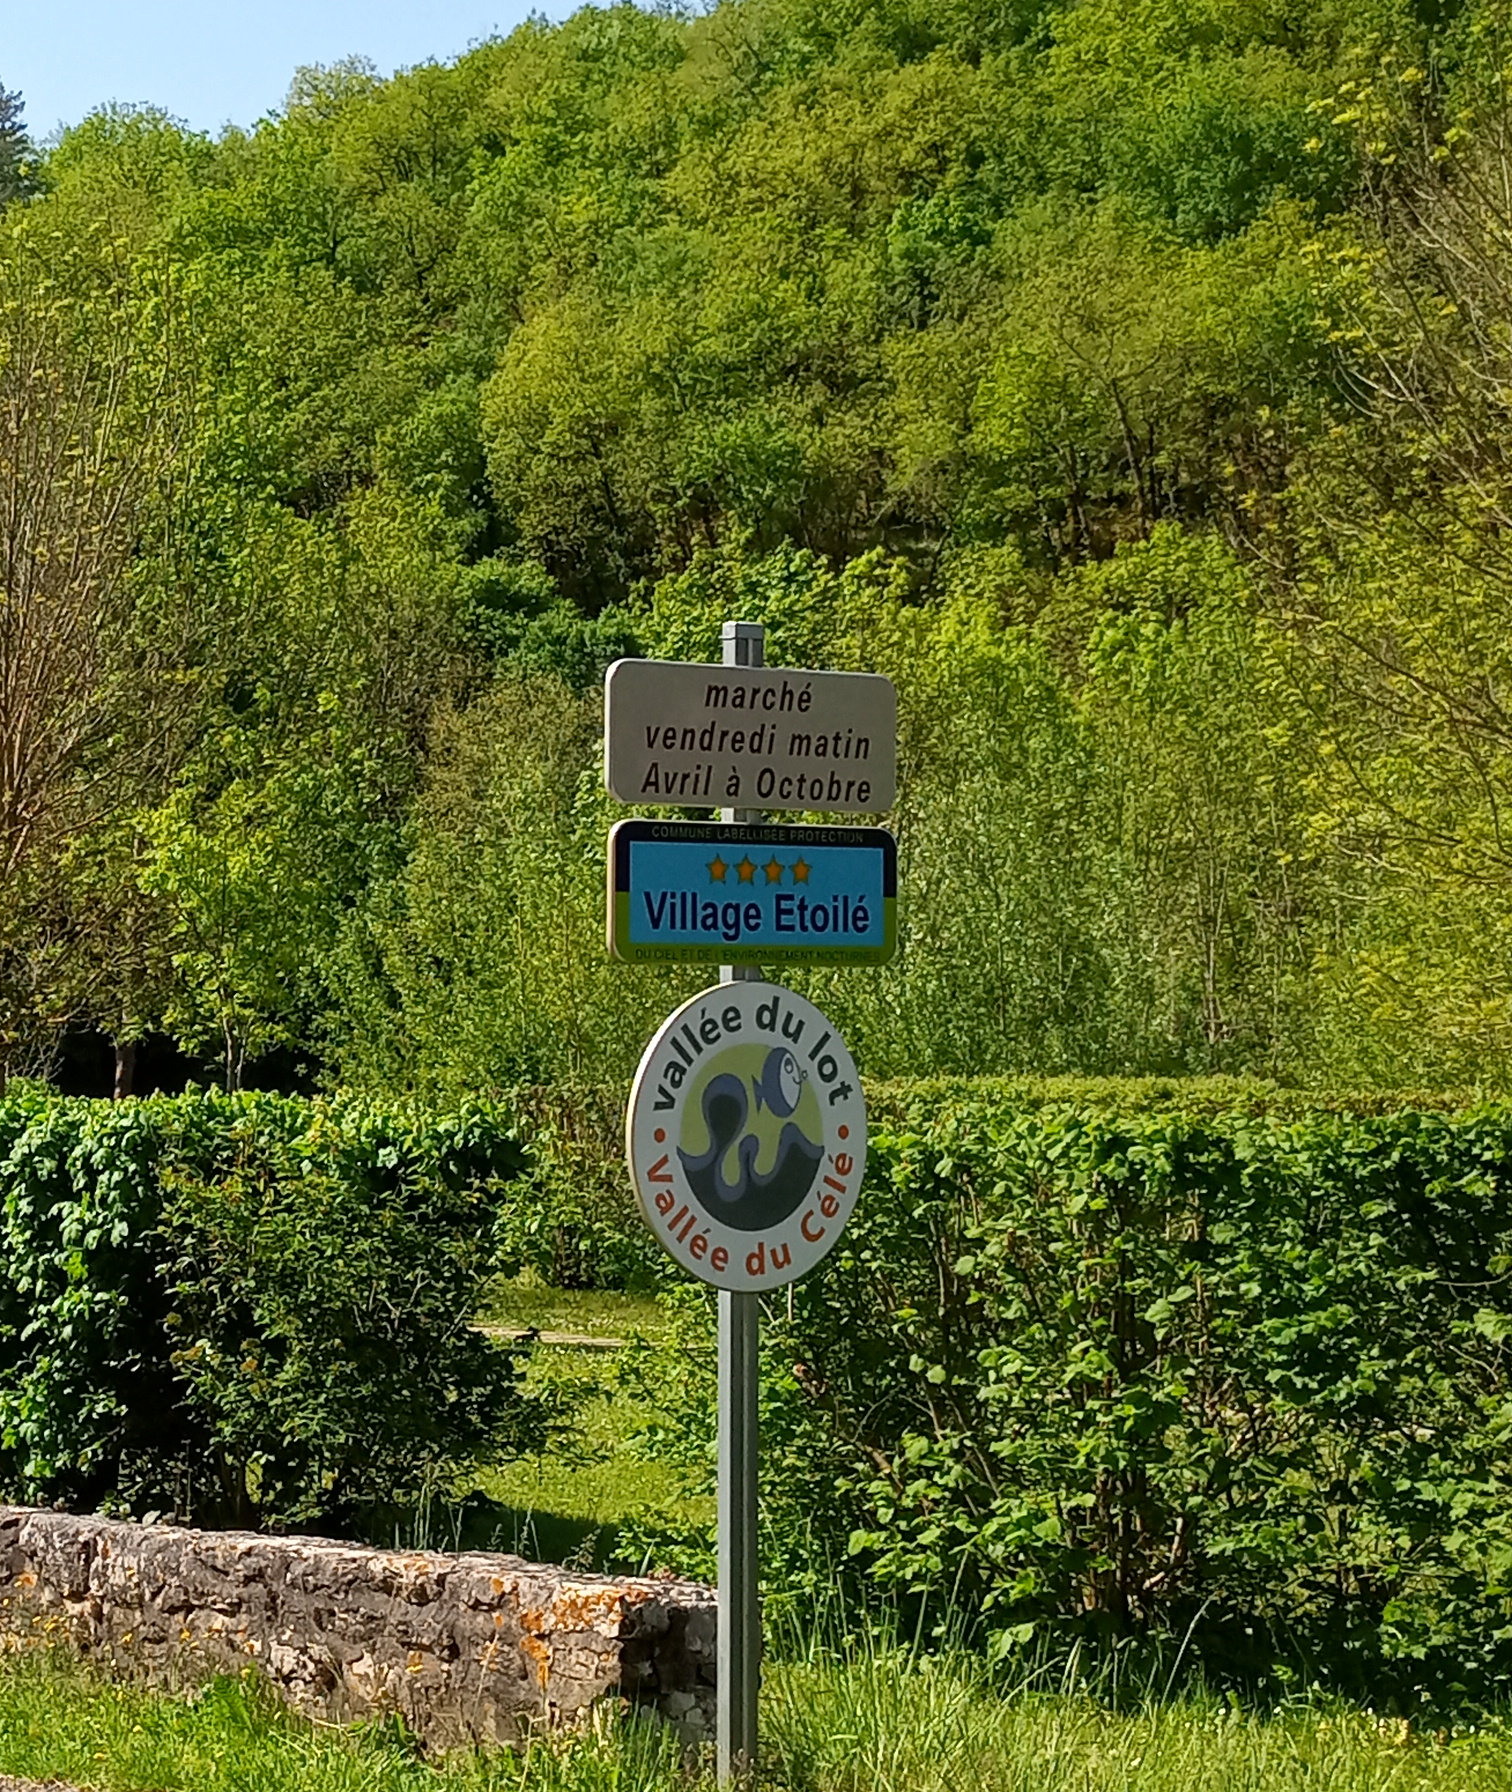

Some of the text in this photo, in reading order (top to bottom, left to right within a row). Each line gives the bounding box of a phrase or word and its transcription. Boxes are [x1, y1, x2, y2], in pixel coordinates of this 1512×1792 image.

[704, 681, 812, 713] marché
[646, 721, 870, 760] vendredi matin
[641, 762, 872, 803] Avril à Octobre
[651, 825, 712, 839] COMMUNE
[790, 829, 864, 843] PROTECTION
[643, 891, 870, 942] Village Etoilé
[653, 995, 854, 1112] vallée du lot
[646, 1152, 854, 1276] Vallée du Célé
